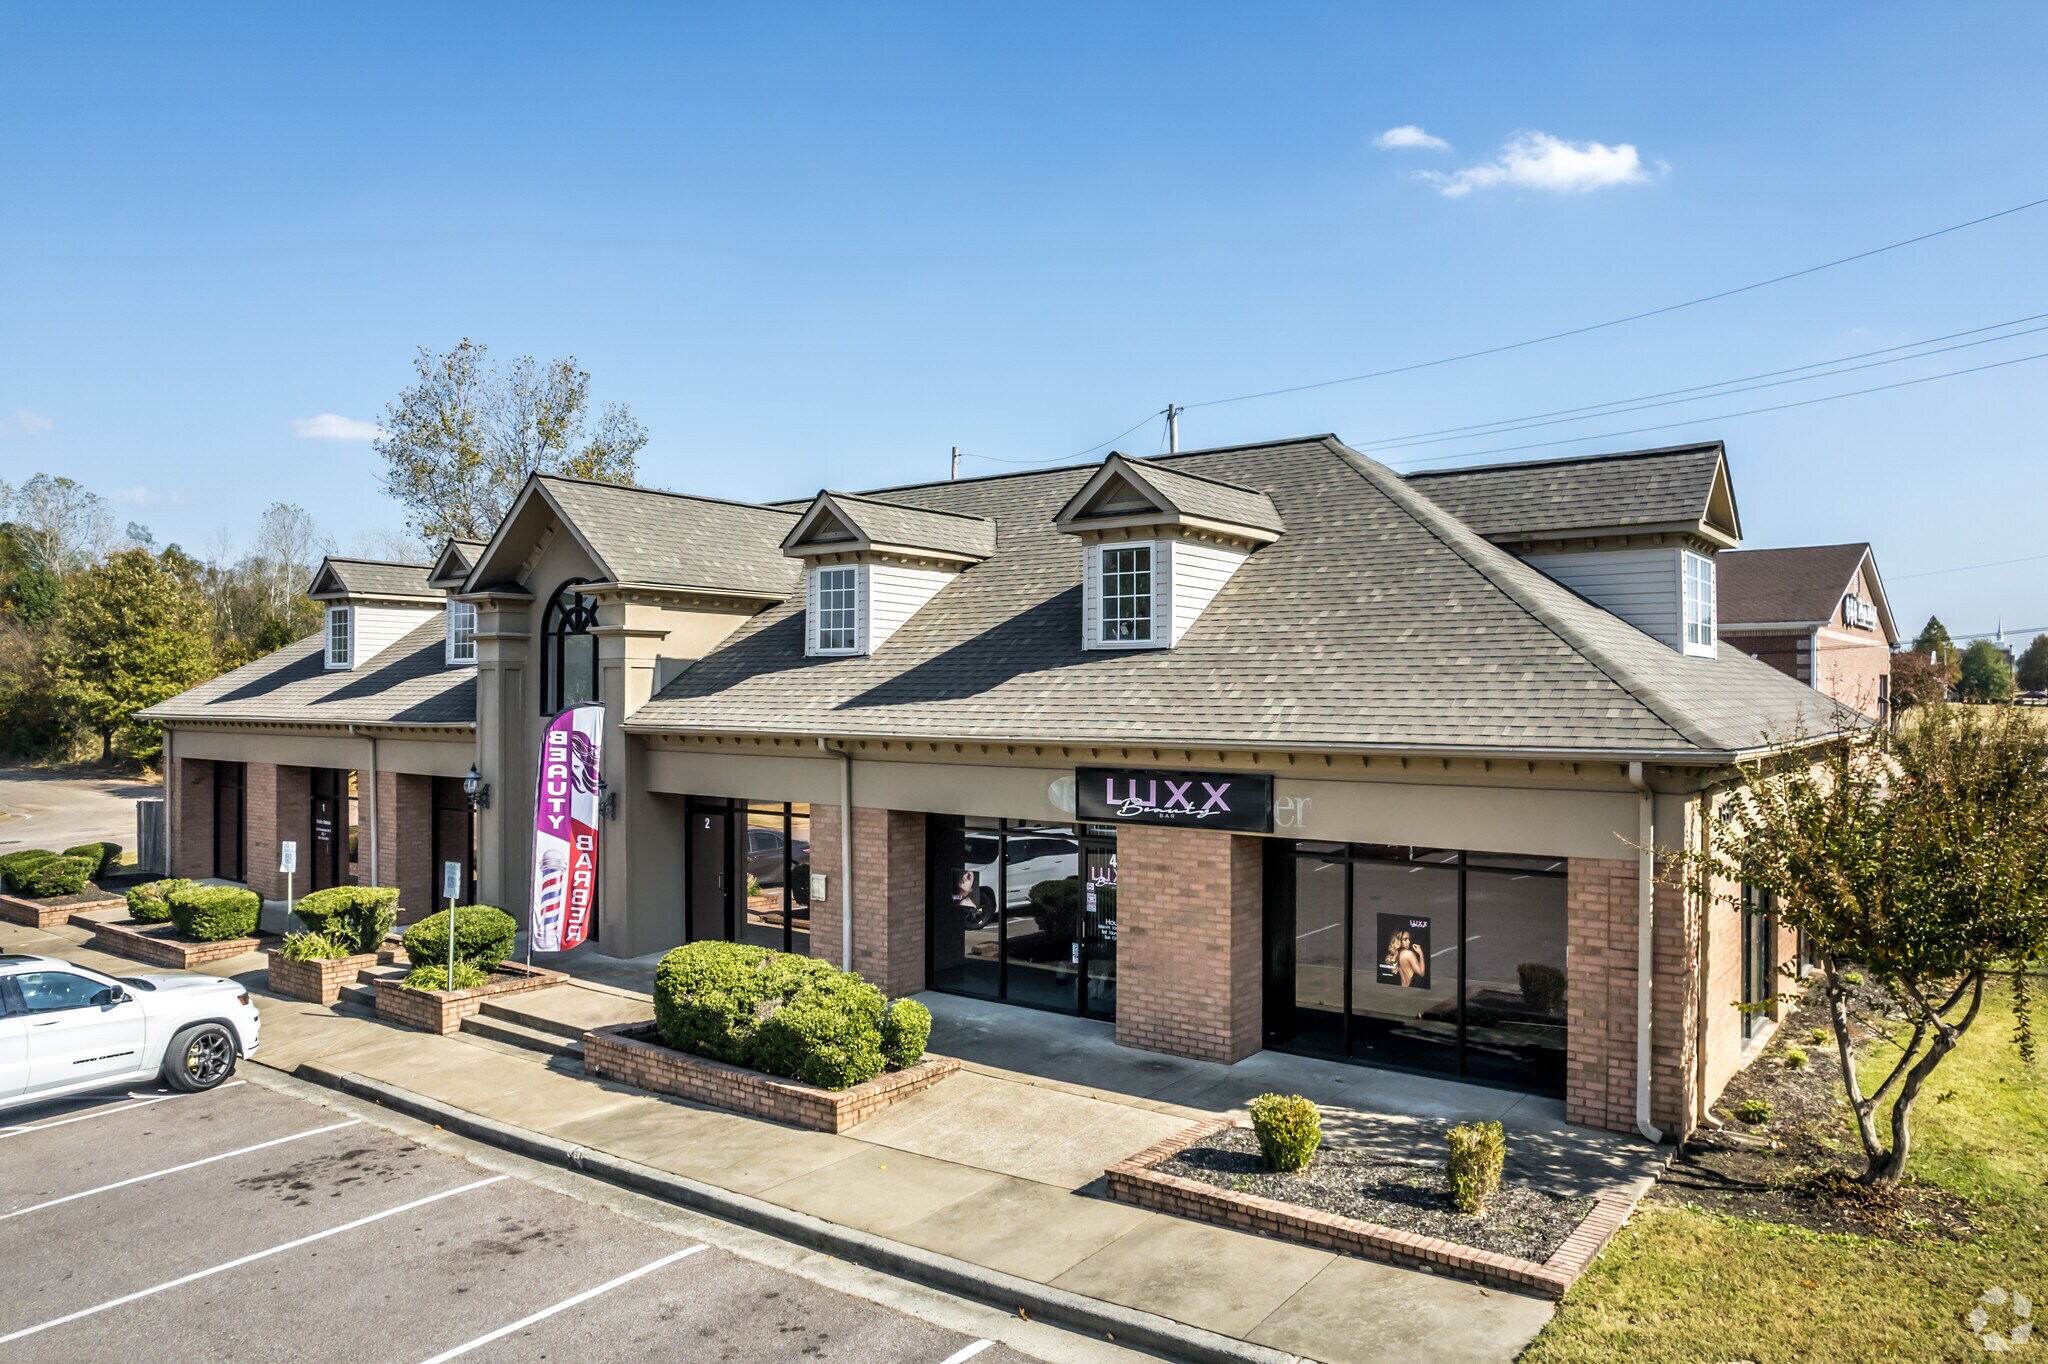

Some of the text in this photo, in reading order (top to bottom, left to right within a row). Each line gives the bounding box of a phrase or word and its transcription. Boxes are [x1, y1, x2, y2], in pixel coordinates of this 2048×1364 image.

[1106, 778, 1231, 811] LUXX
[322, 803, 326, 812] 1
[1116, 797, 1220, 818] Beauty
[704, 818, 710, 829] 2
[1110, 854, 1117, 867] 4
